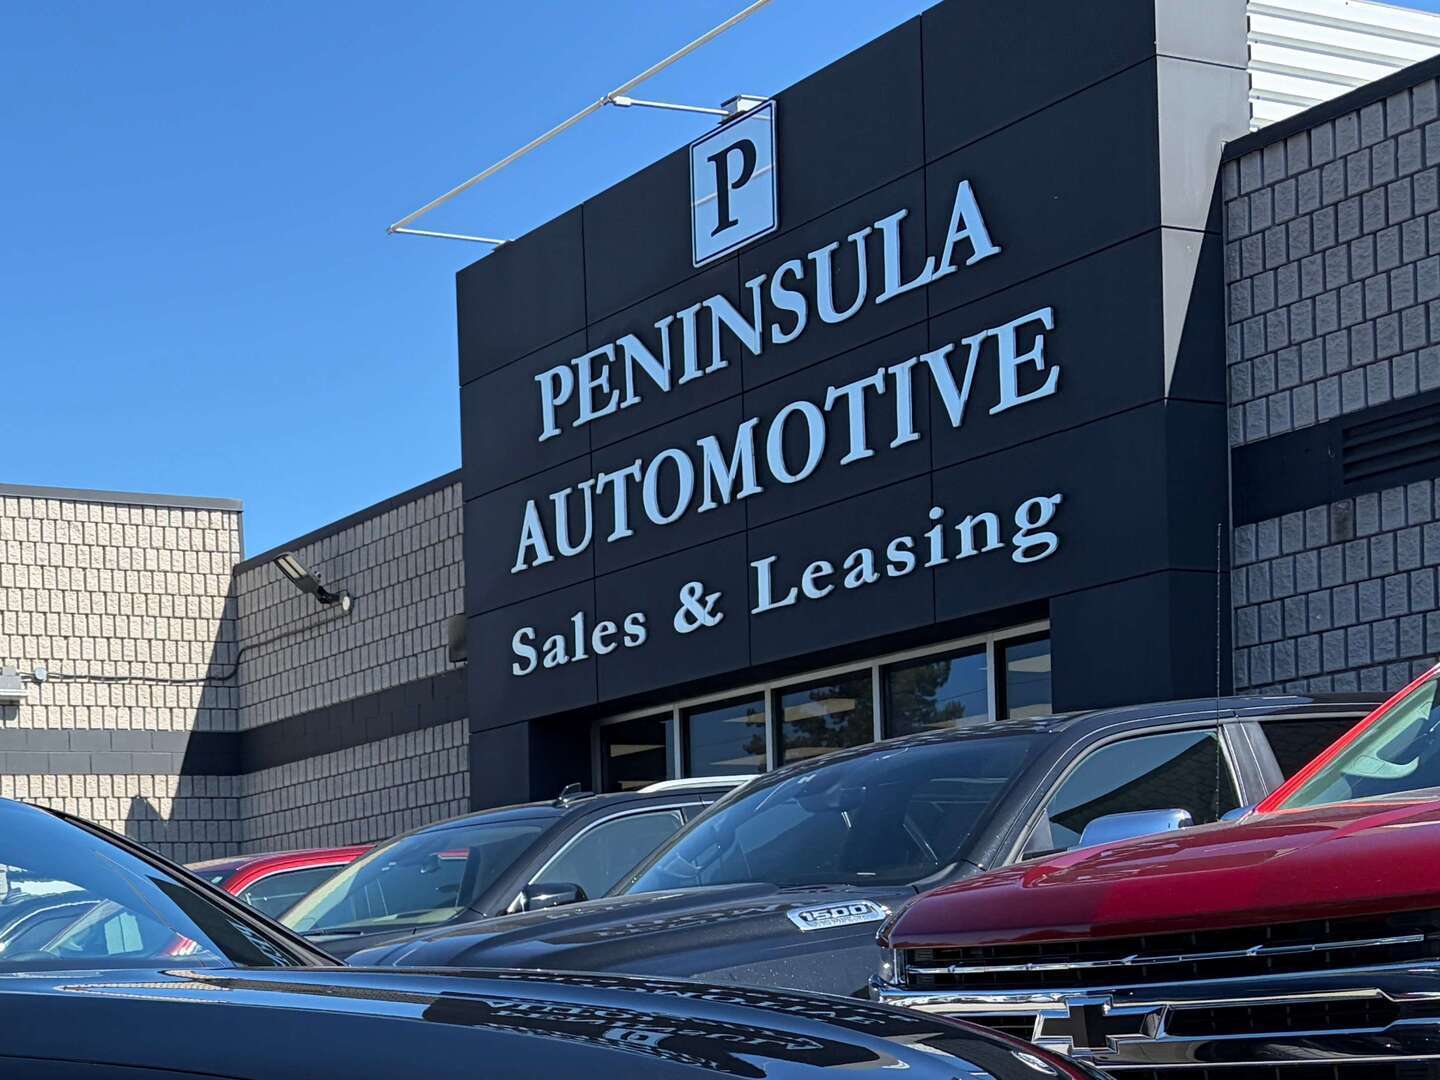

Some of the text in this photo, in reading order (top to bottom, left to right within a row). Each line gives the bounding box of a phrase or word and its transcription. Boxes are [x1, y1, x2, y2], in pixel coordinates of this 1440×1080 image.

[707, 138, 757, 238] P
[535, 180, 1002, 442] PENINSULA
[511, 306, 1060, 574] AUTOMOTIVE
[512, 492, 1063, 677] Sales & Leasing
[799, 904, 869, 921] 1500
